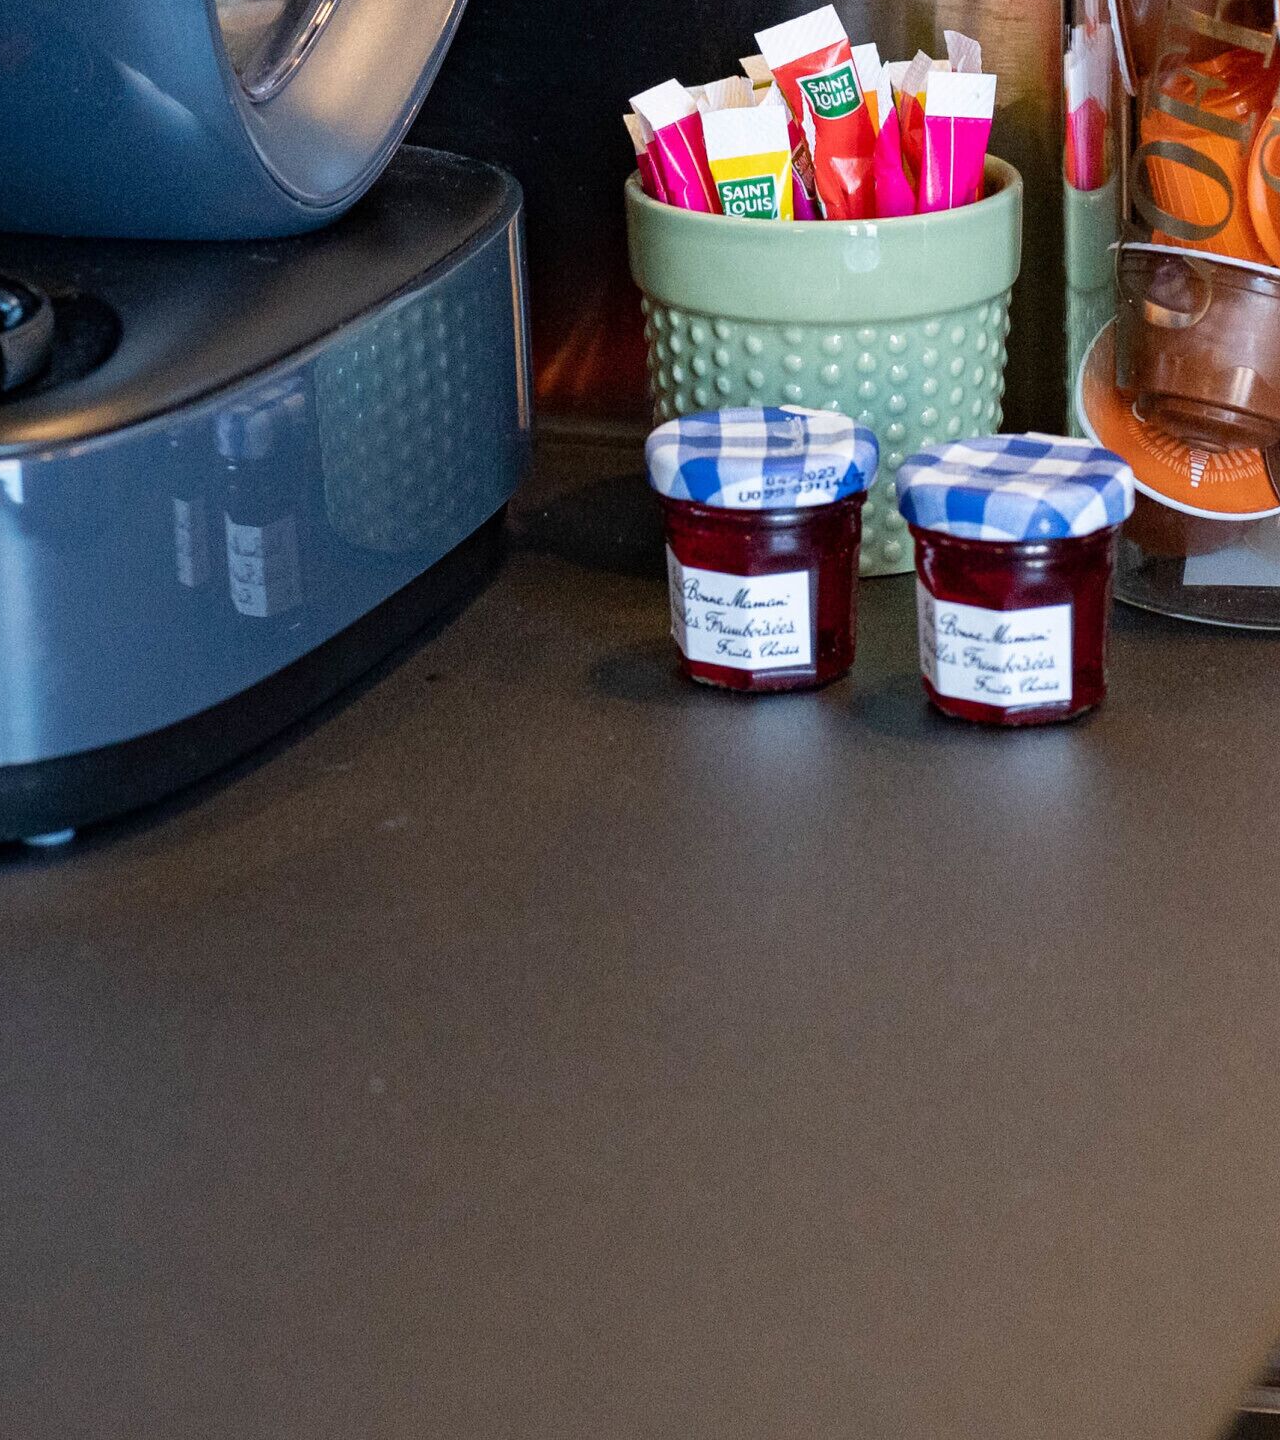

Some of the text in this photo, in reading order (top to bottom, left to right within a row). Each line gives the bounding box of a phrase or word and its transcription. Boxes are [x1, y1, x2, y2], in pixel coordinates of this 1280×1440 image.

[807, 73, 849, 94] SAINT
[812, 86, 855, 111] LOUIS
[722, 182, 771, 201] SAINT
[724, 196, 773, 217] LOUIS
[684, 577, 787, 609] Bonne Maman
